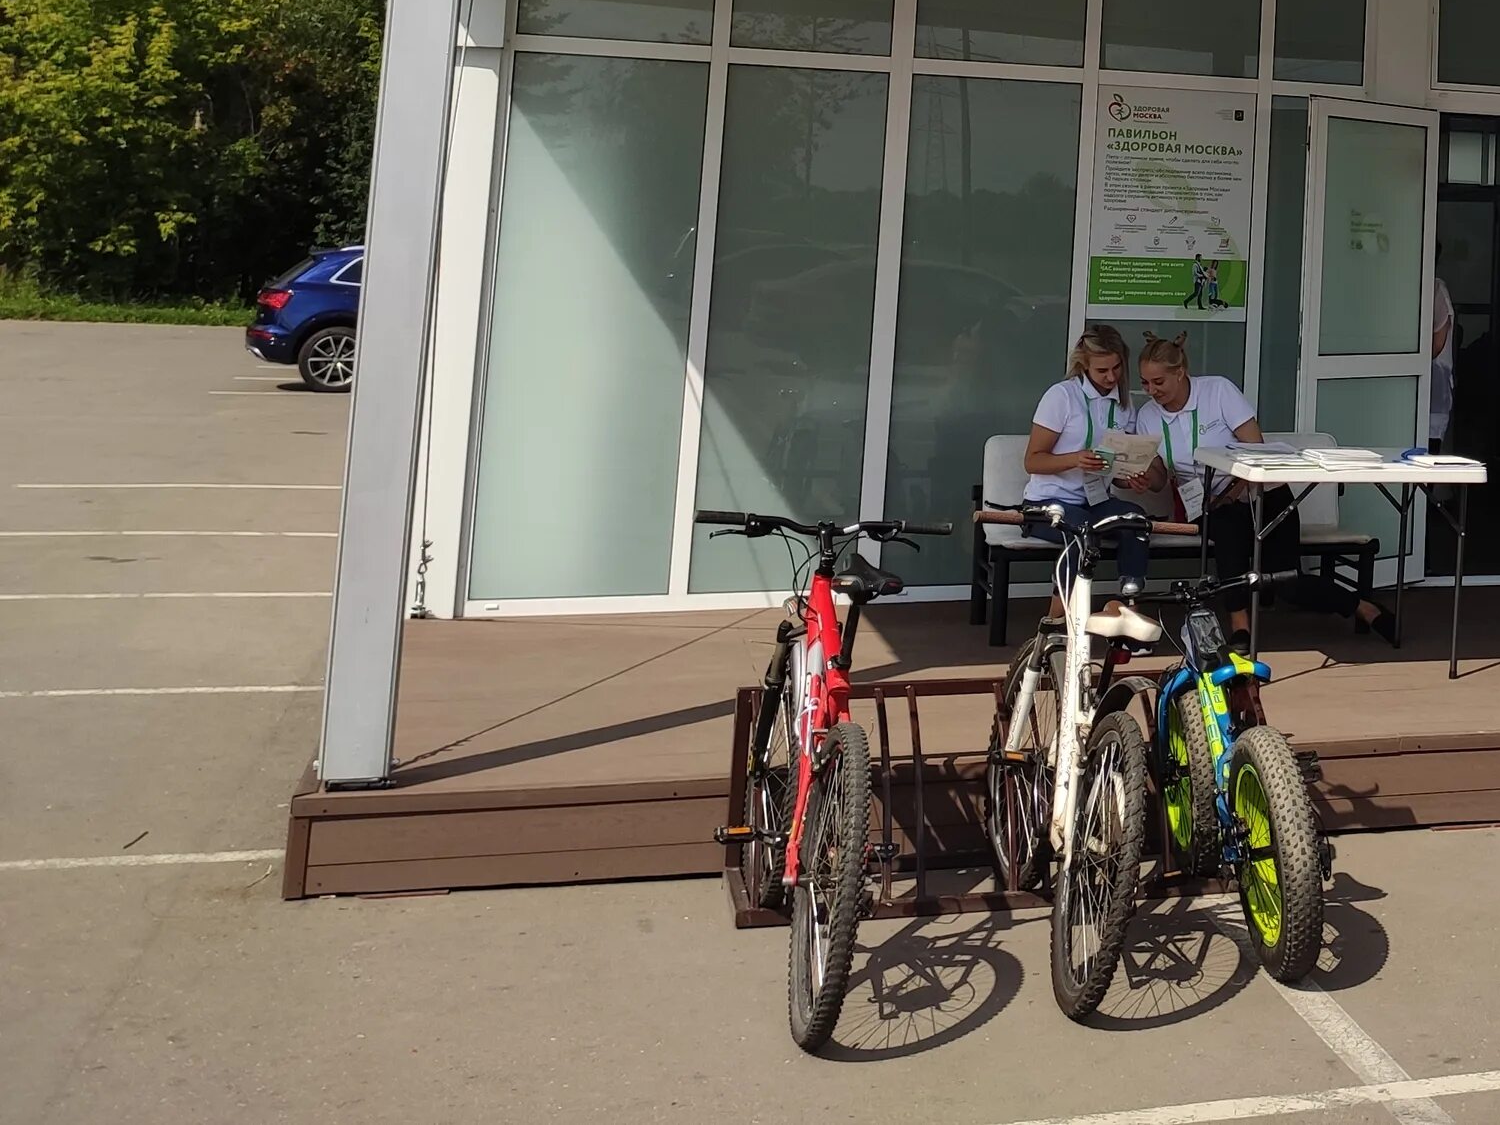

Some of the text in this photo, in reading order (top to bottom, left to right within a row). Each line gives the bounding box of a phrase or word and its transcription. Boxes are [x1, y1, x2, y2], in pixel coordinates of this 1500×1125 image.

[1133, 105, 1170, 113] ЗДОРОВАЯ
[1132, 112, 1162, 120] МОСКВА
[1107, 127, 1178, 141] ПАВИЛЬОН
[1106, 140, 1243, 157] «ЗДОРОВАЯ МОСКВА»
